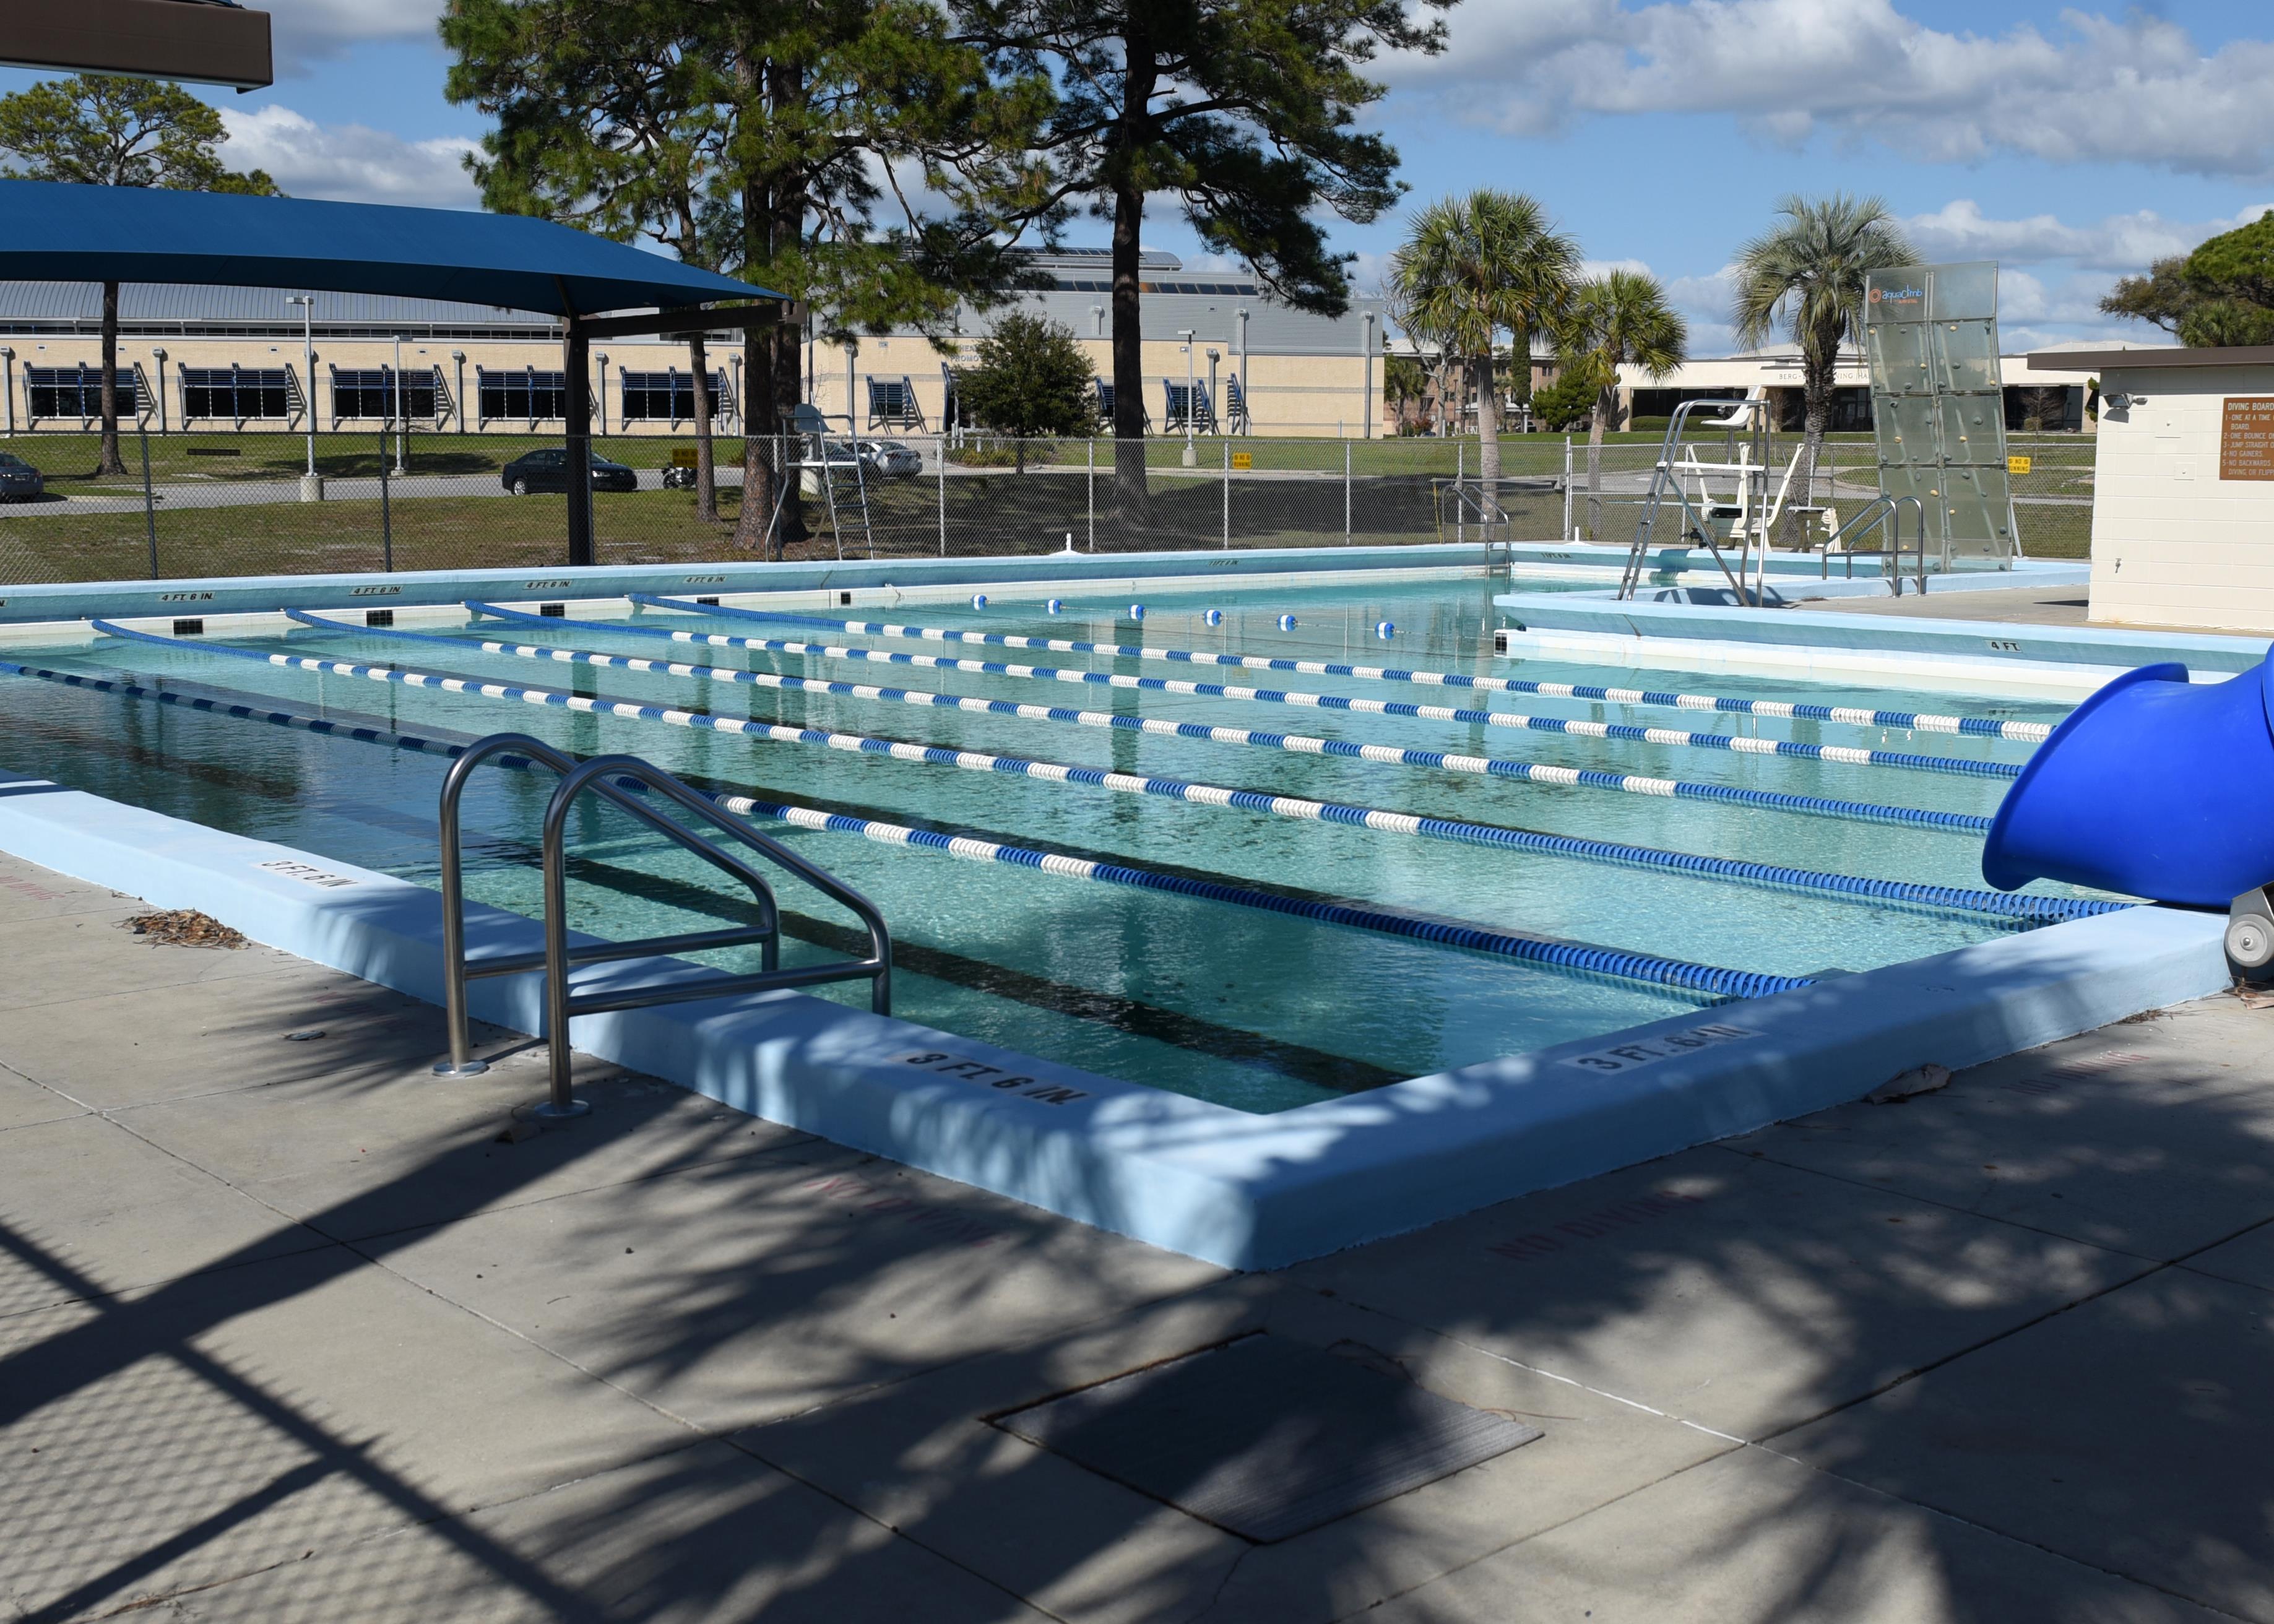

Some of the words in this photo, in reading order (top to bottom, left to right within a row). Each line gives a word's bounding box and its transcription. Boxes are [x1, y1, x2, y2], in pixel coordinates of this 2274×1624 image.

[951, 354, 982, 362] PROMO
[2228, 402, 2249, 411] DIVING
[1991, 641, 2000, 650] 4
[1576, 1057, 1623, 1070] 3
[1664, 1036, 1706, 1047] 6
[906, 1053, 949, 1065] 3
[991, 1077, 1035, 1089] 6
